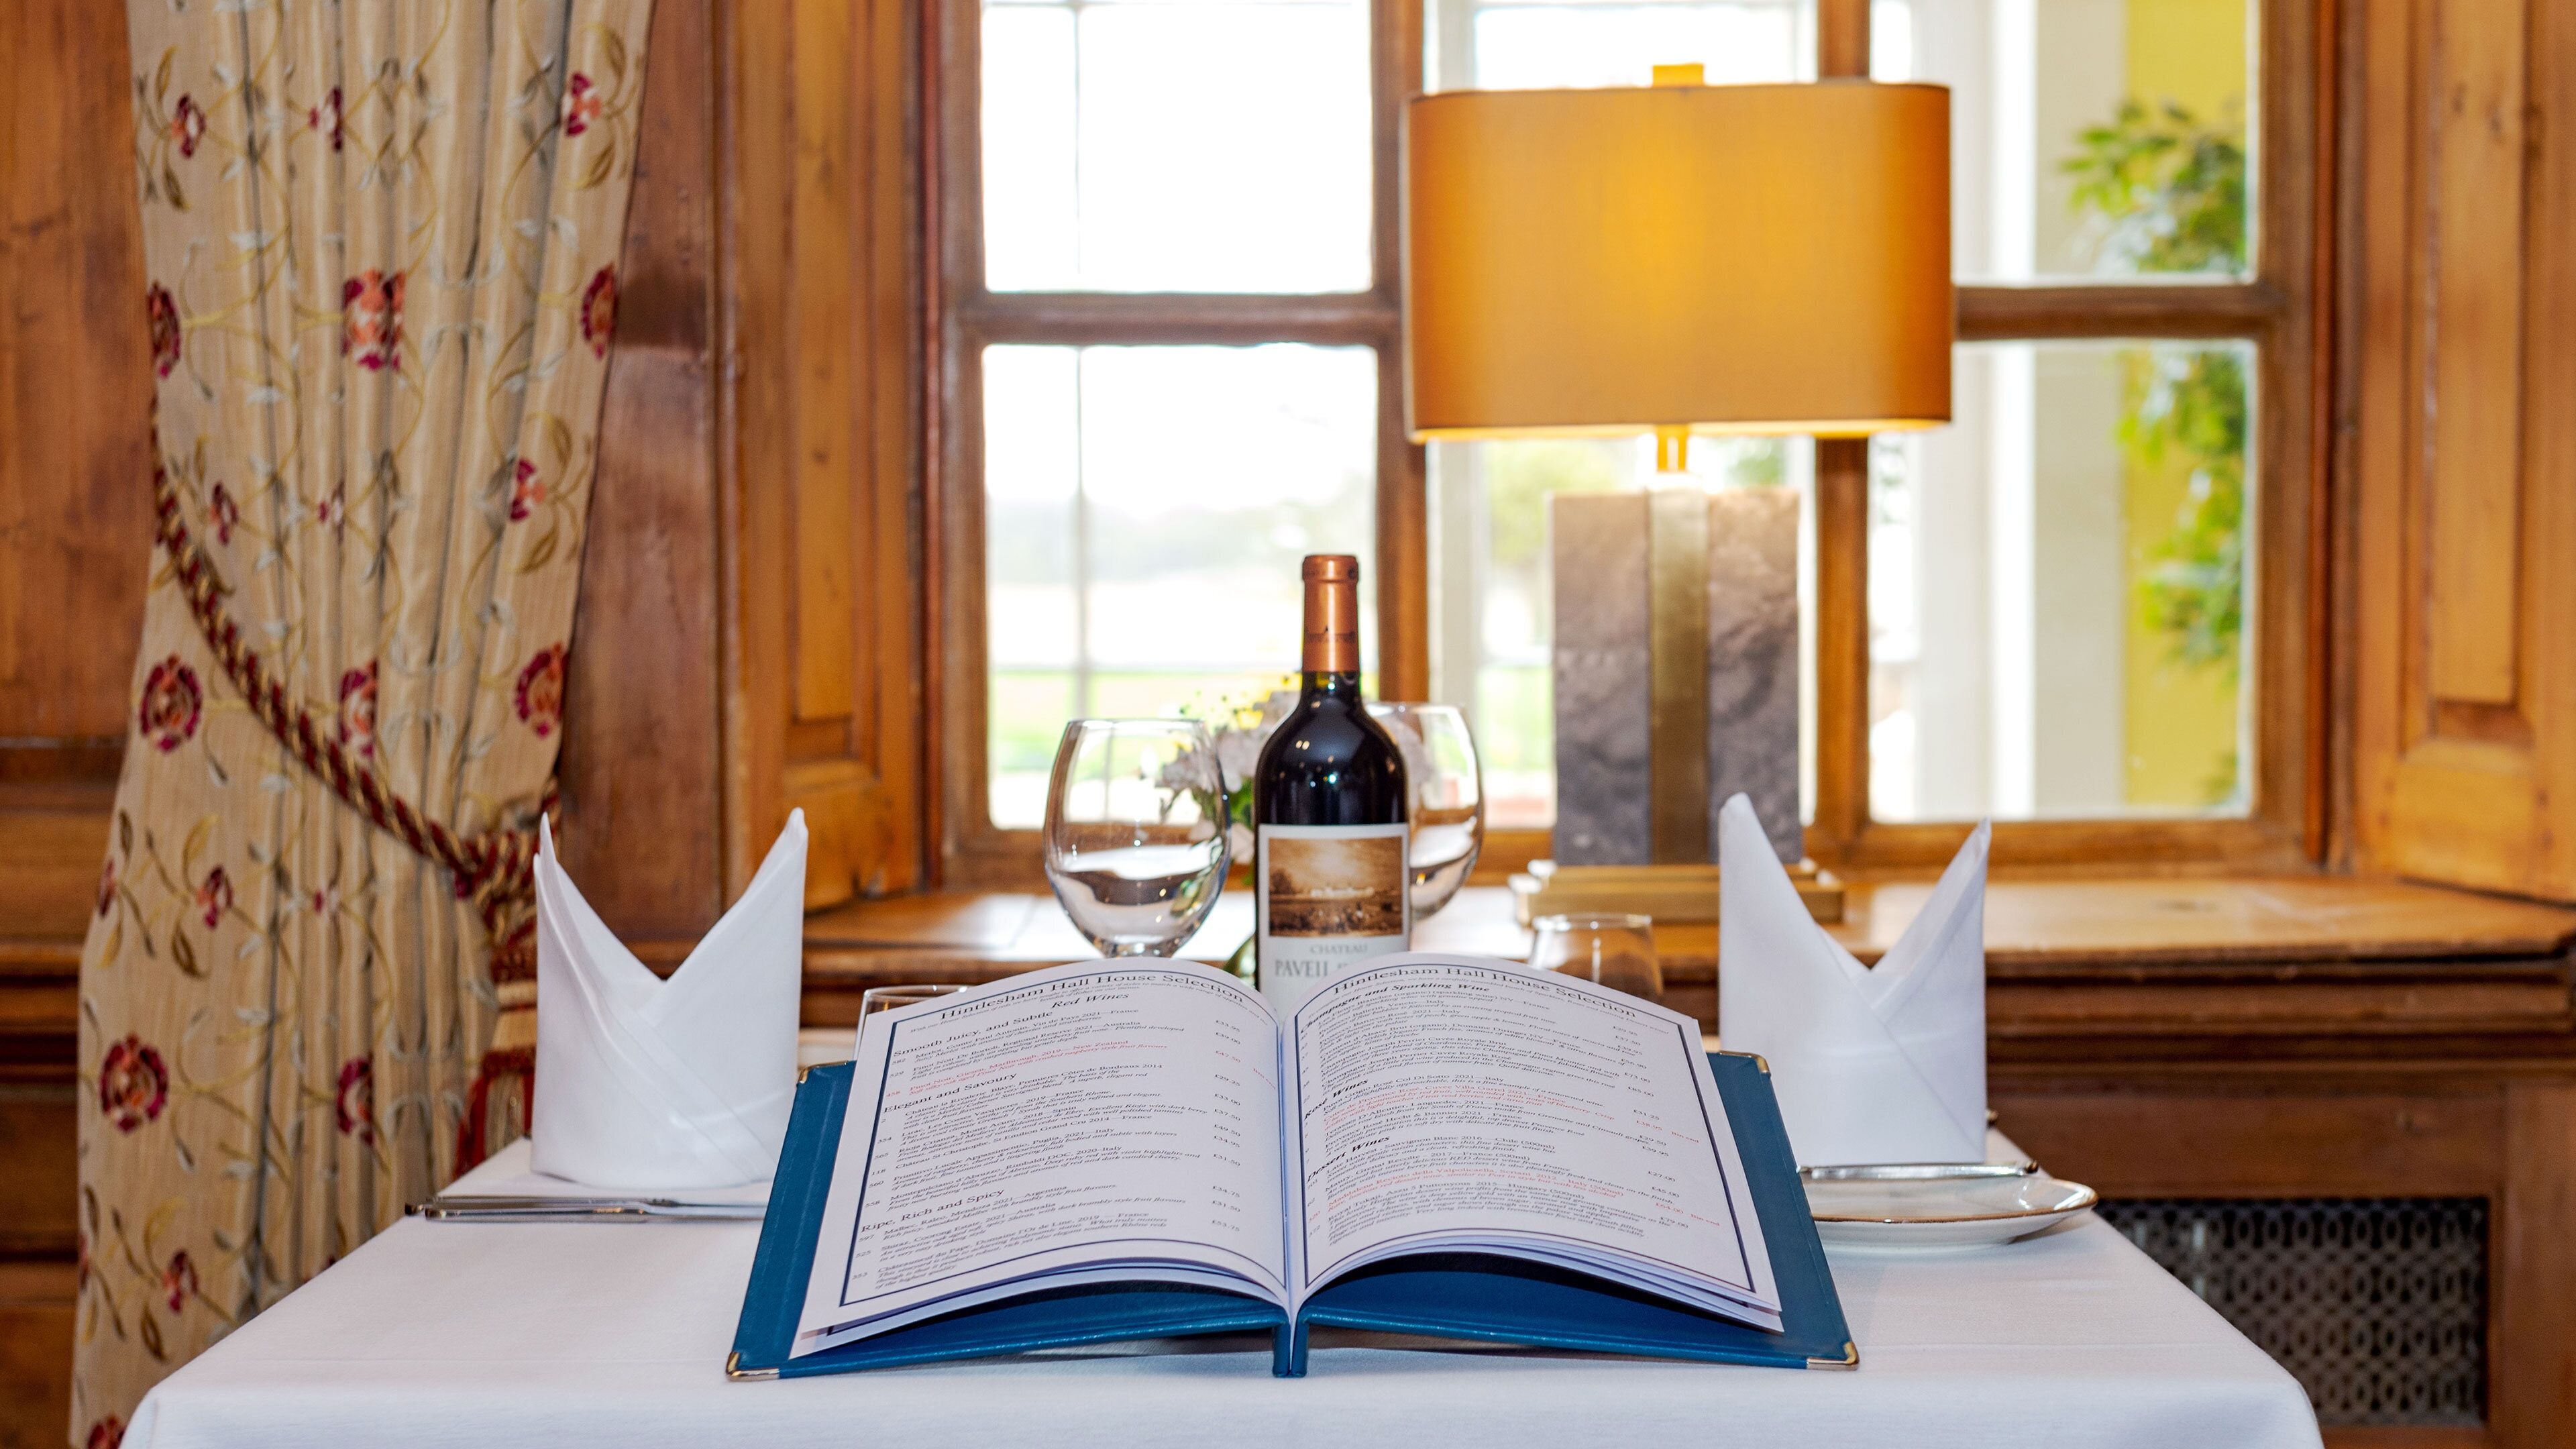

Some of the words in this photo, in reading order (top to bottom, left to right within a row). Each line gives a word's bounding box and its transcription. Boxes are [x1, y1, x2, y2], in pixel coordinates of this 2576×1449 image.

[1309, 943, 1368, 954] CHATEAU
[941, 989, 1043, 1020] Hintlesham
[1051, 978, 1089, 991] Hall
[1097, 975, 1156, 983] House
[1163, 975, 1242, 1002] Selection
[1334, 969, 1438, 995] Hintlesham
[1447, 968, 1485, 977] Hall
[1493, 973, 1550, 991] House
[1556, 987, 1635, 1018] Selection
[1051, 998, 1080, 1009] Red
[1086, 994, 1128, 1002] Wines
[1300, 994, 1362, 1034] Champagne
[1364, 986, 1389, 997] and
[1391, 983, 1452, 991] Sparkling
[1216, 1020, 1240, 1032] £33.95
[894, 1040, 942, 1057] Smooth
[947, 1030, 981, 1042] Juicy,
[985, 1021, 1009, 1032] and
[1013, 1012, 1053, 1024] Subtle
[1216, 1032, 1241, 1044] £39.00
[1214, 1074, 1240, 1087] £29.25
[883, 1095, 932, 1113] Elegant
[936, 1087, 960, 1099] and
[964, 1073, 1017, 1091] Savoury
[1214, 1093, 1241, 1106] £33.00
[1304, 1098, 1328, 1120] Rosé
[1333, 1080, 1368, 1098] Wines
[1214, 1108, 1241, 1121] £37.50
[1633, 1109, 1660, 1120] £31.25
[1214, 1124, 1240, 1137] £49.50
[1640, 1134, 1667, 1146] £29.50
[1642, 1145, 1669, 1157] £39.95
[1307, 1151, 1346, 1183] Dessert
[1352, 1137, 1389, 1152] Wines
[1648, 1171, 1676, 1182] £27.00
[1212, 1185, 1240, 1197] £34.75
[1652, 1186, 1680, 1198] £45.00
[861, 1220, 896, 1233] Ripe,
[901, 1208, 932, 1222] Rich
[936, 1199, 963, 1212] and
[967, 1189, 1004, 1203] Spicy
[1660, 1216, 1688, 1228] £79.00
